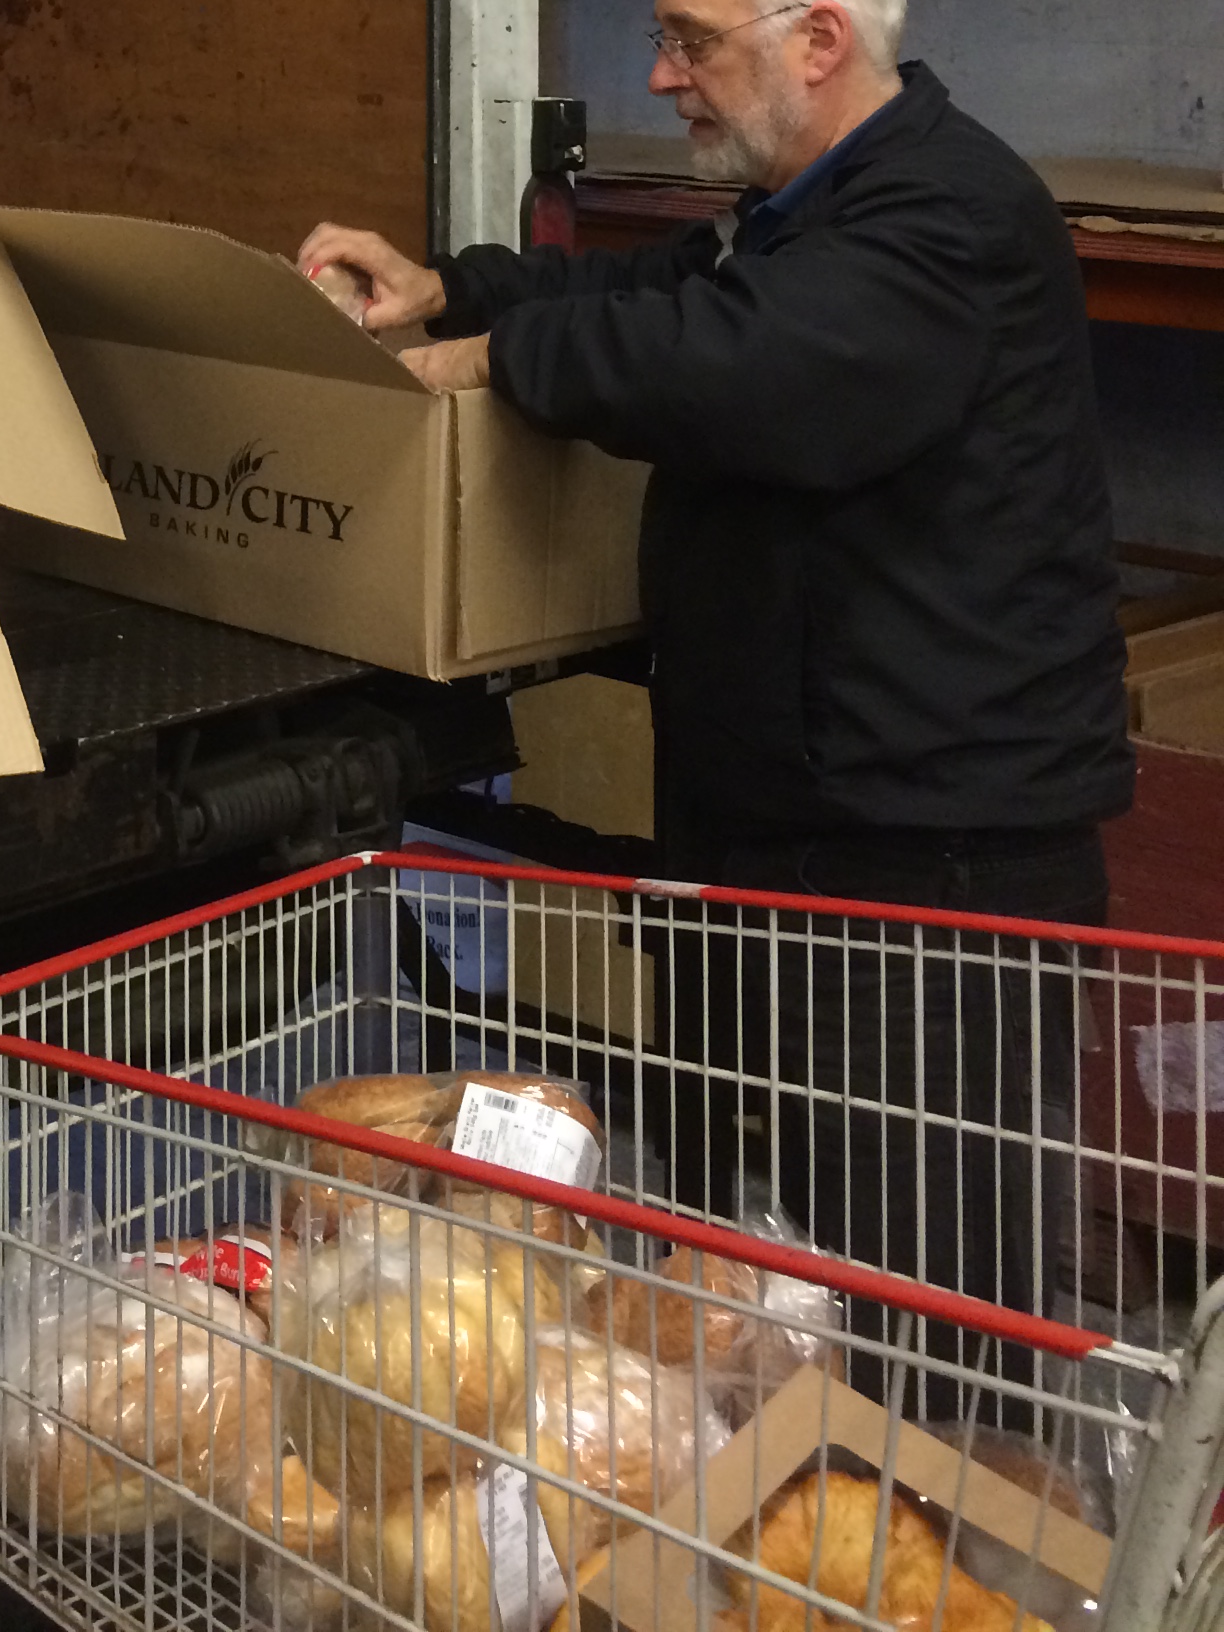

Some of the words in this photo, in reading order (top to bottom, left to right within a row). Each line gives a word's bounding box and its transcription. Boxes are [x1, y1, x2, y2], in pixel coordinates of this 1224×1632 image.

[94, 452, 220, 511] LAND
[241, 484, 355, 542] CITY
[149, 512, 251, 549] BAKING
